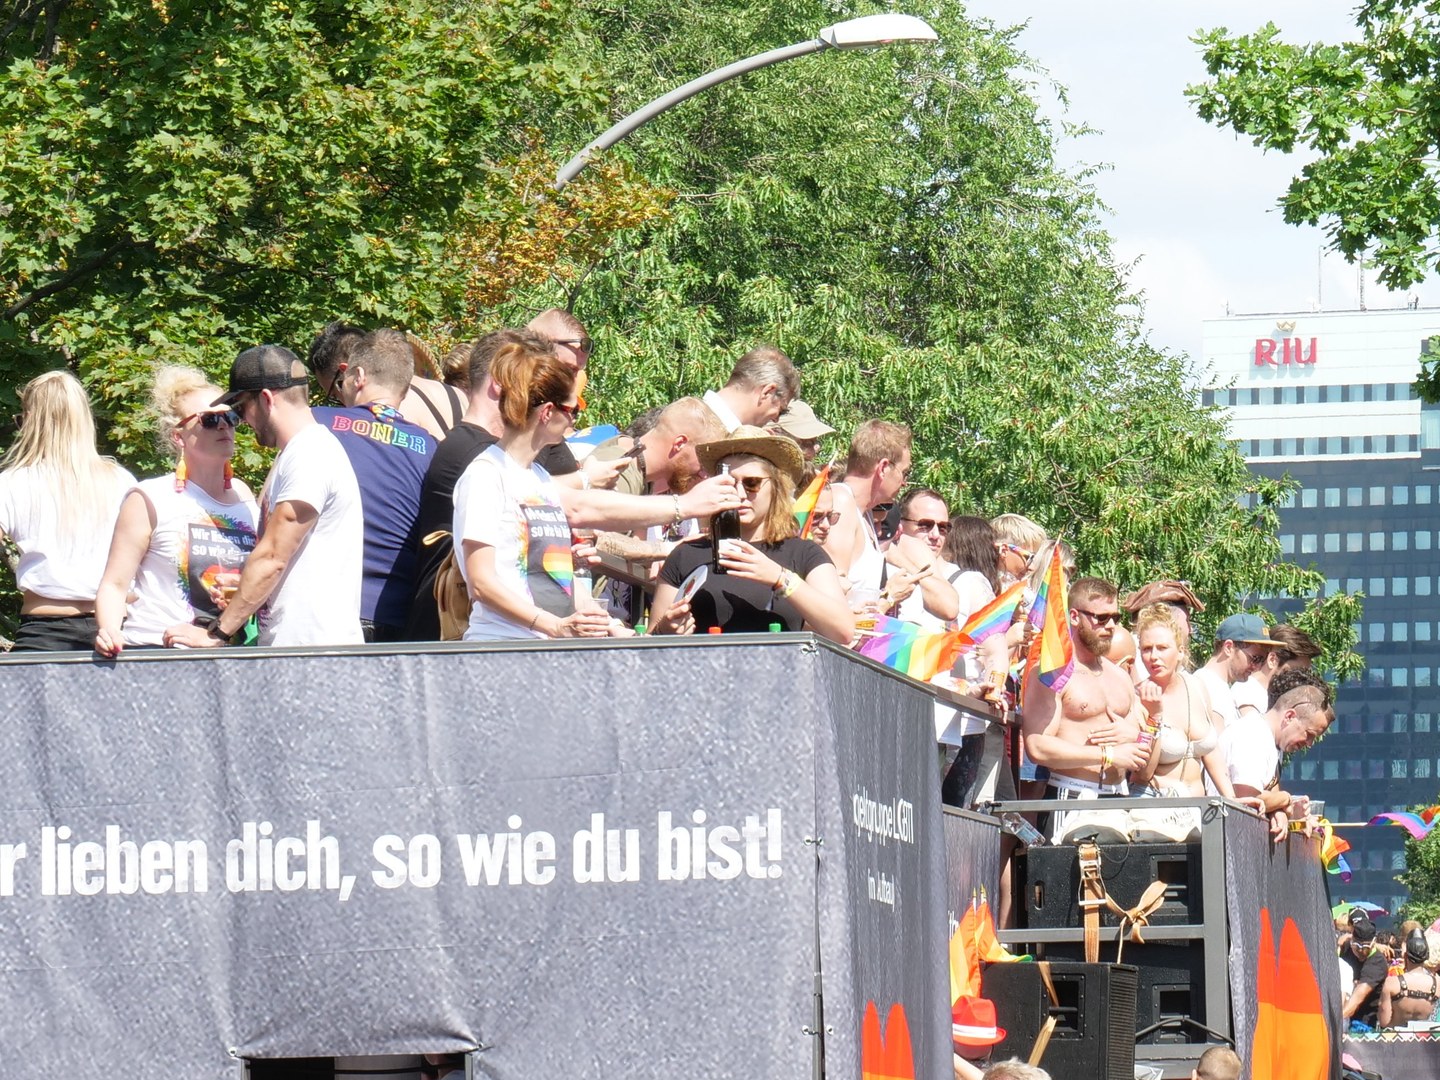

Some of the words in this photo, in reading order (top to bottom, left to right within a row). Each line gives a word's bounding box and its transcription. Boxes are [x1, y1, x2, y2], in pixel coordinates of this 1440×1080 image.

[1254, 337, 1317, 366] RIU
[332, 415, 426, 455] BONER
[191, 527, 210, 541] Wir
[192, 545, 206, 556] so
[0, 842, 26, 896] r
[41, 825, 208, 896] lieben
[225, 820, 357, 901] dich,
[372, 833, 442, 889] so
[457, 814, 556, 886] wie
[572, 811, 640, 883] du
[658, 808, 783, 881] bist!
